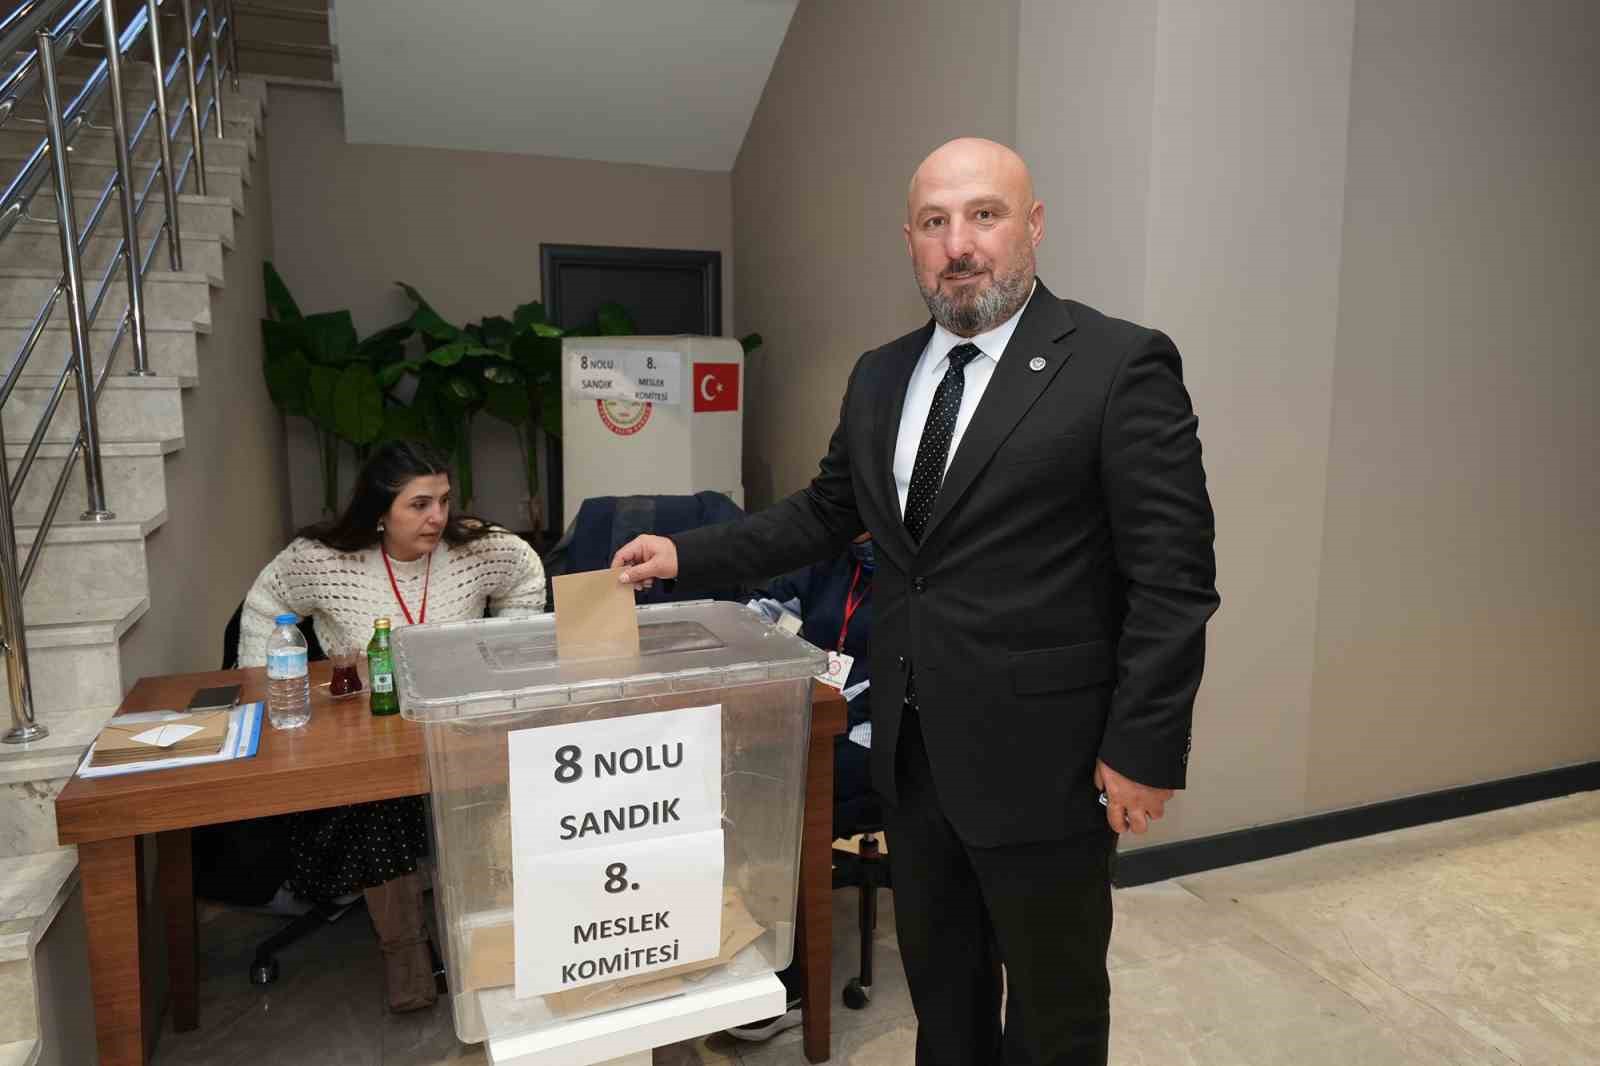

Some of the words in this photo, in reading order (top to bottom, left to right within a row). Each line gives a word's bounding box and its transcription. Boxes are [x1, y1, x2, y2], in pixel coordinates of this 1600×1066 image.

[580, 356, 588, 370] 8
[590, 360, 614, 369] NOLU
[646, 357, 657, 370] 8.
[581, 380, 613, 389] SANDIK
[554, 744, 583, 783] 8
[594, 742, 683, 778] NOLU
[559, 798, 680, 840] SANDIK
[604, 862, 640, 894] 8.
[573, 911, 670, 944] MESLEK
[561, 939, 679, 984] KOMİTESİ
